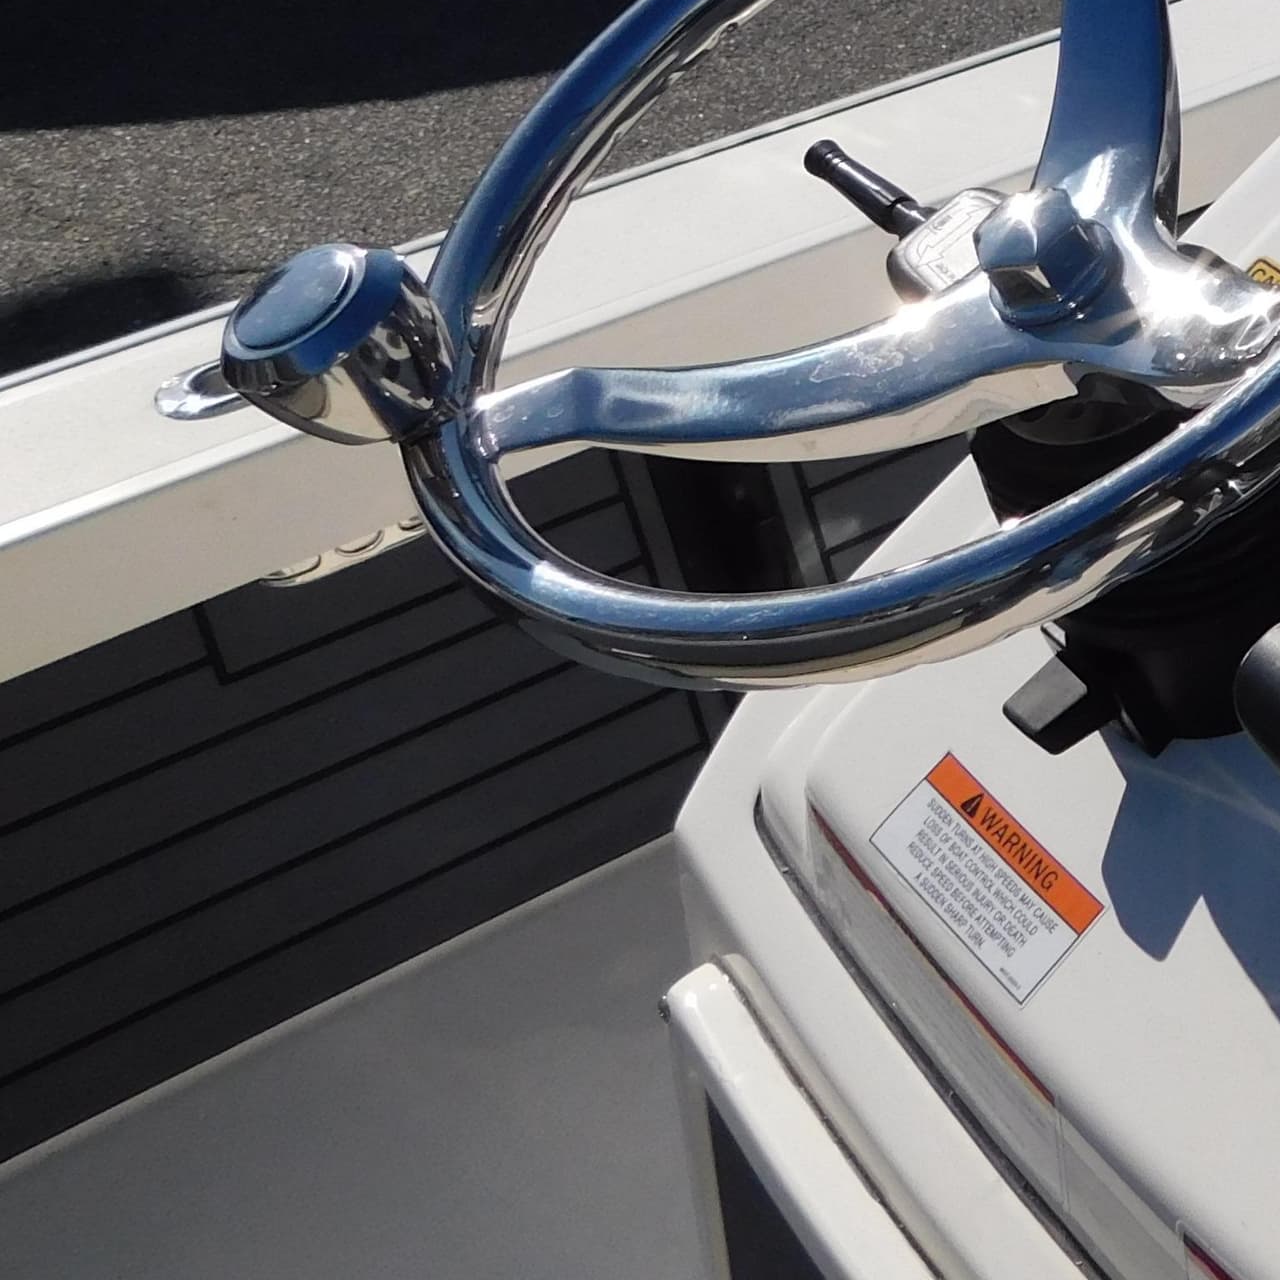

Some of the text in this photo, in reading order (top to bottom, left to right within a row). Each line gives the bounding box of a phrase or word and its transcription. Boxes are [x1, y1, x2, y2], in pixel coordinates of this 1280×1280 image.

[907, 841, 933, 870] REDUCE
[931, 867, 953, 892] SPEED
[951, 888, 978, 918] BEFORE
[975, 913, 1015, 957] ATTEMPTING
[915, 871, 922, 881] A
[919, 876, 947, 907] SUDDEN
[944, 902, 967, 929] SHARP
[917, 829, 940, 856] RESULT
[939, 852, 948, 864] IN
[946, 860, 974, 891] SERIOUS
[972, 887, 995, 913] INJURY
[994, 910, 1006, 925] OR
[924, 816, 1038, 936] LOSS OF BOAT CONTROL WHICH COULD
[928, 798, 1057, 933] SUDDEN TURNS AT HIGH SPEEDS MAY CAUSE
[979, 807, 1059, 892] WARNING
